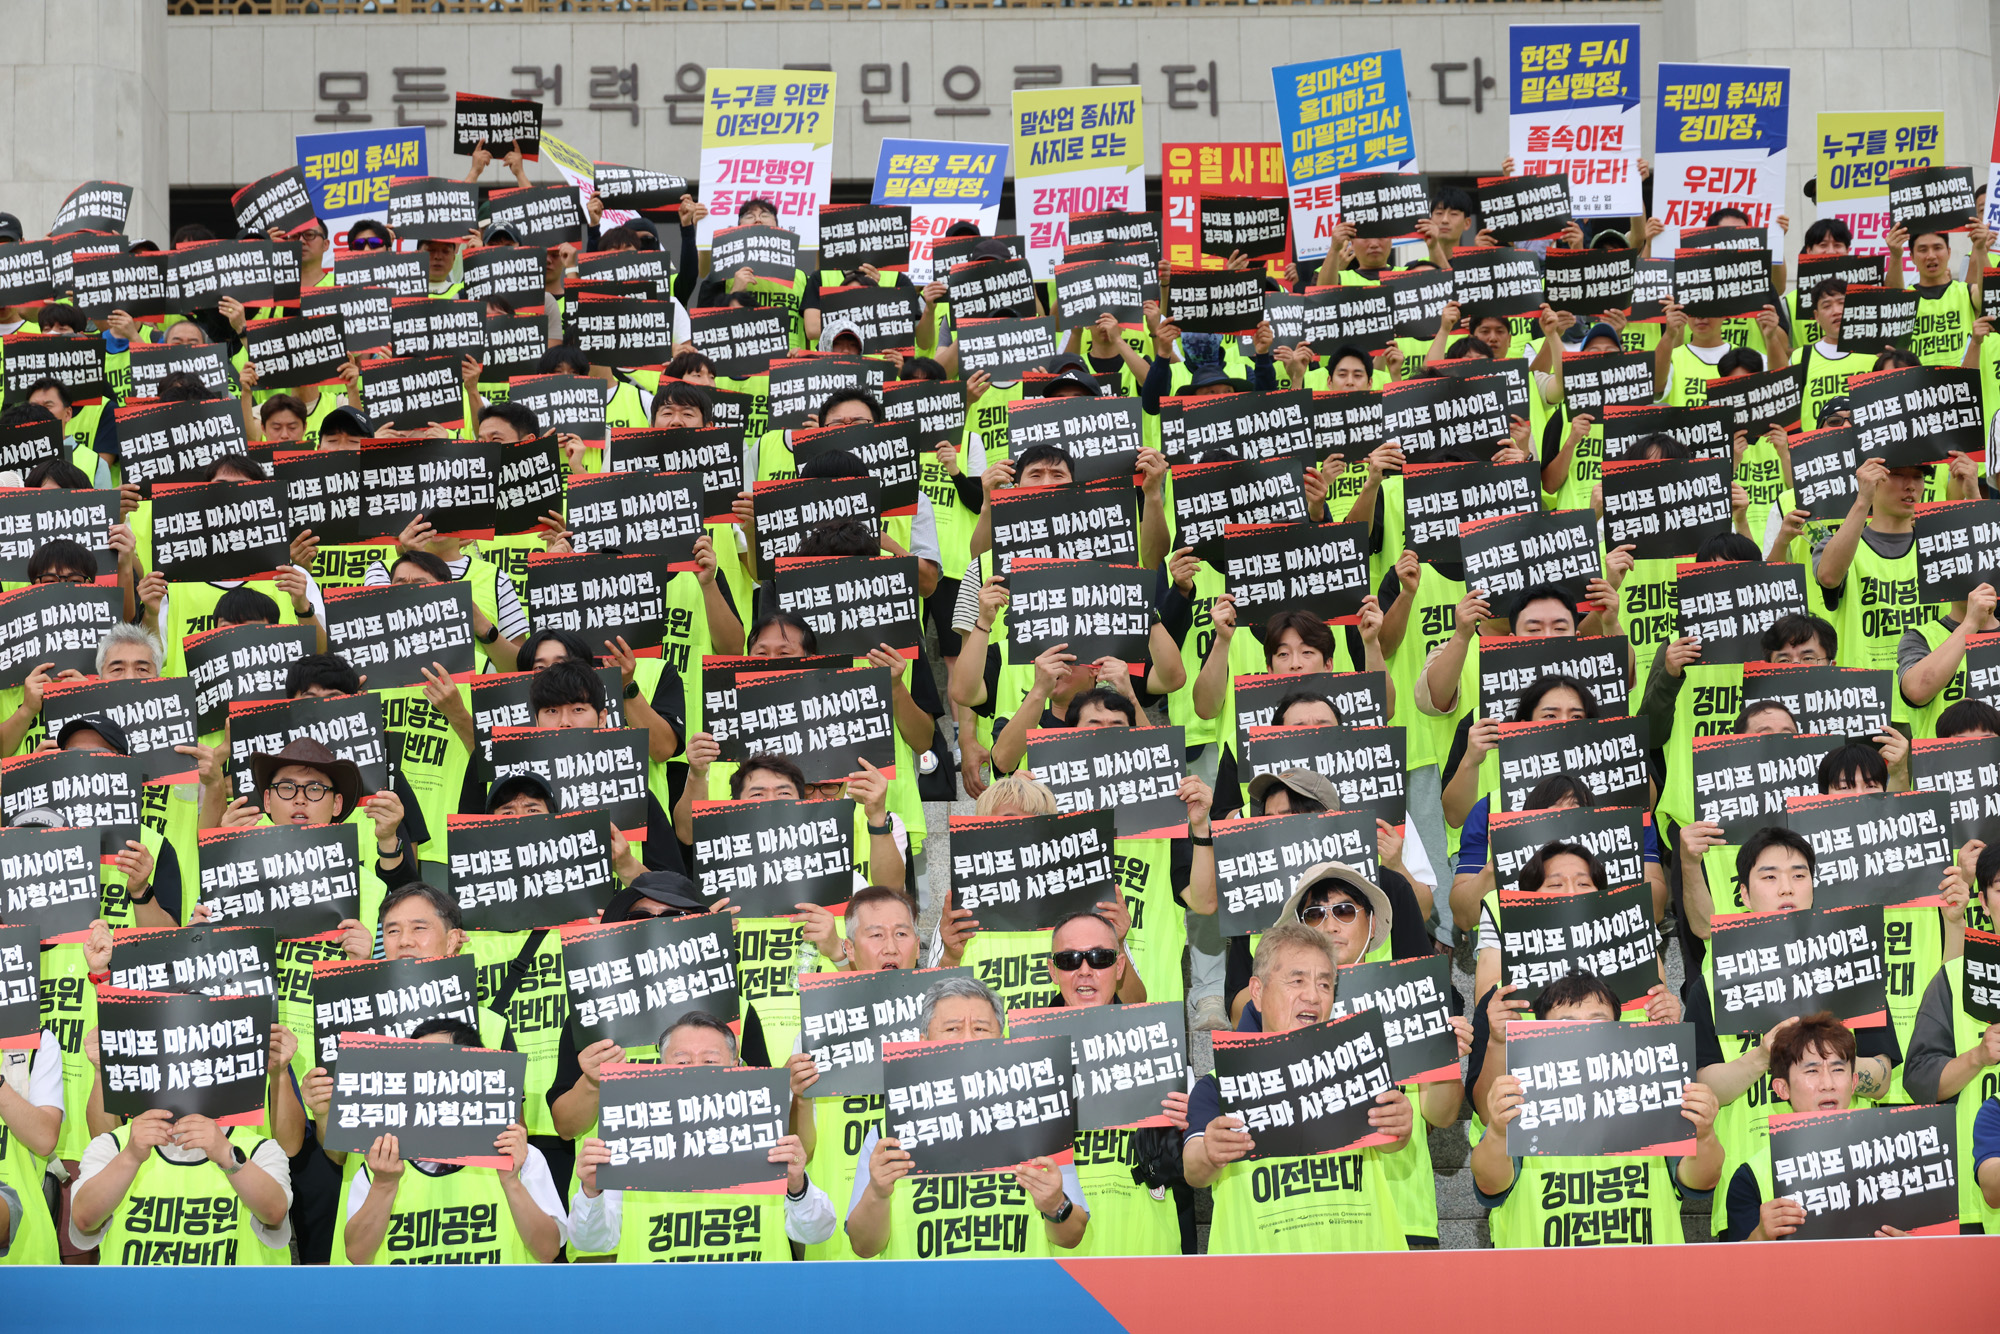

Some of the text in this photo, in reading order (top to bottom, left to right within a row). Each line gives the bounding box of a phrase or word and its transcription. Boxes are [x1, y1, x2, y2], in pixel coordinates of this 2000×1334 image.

[1520, 38, 1629, 73] 현장 무시
[315, 65, 450, 127] 모든
[711, 83, 829, 110] 누구를 위한
[1295, 56, 1382, 98] 경마산업
[1520, 70, 1628, 104] 밀실행정,
[1664, 81, 1782, 112] 국민의 휴식처
[1020, 100, 1136, 137] 말산업 종사자
[1299, 84, 1386, 124] 홀대하고
[716, 112, 819, 138] 이전인가?
[1292, 106, 1401, 154] 마필관리사
[1527, 124, 1624, 152] 졸속이전
[1680, 114, 1763, 142] 경마장,
[1823, 125, 1938, 159] 누구를 위한
[305, 140, 419, 181] 국민의 휴식처
[889, 154, 996, 175] 현장 무시
[1030, 132, 1127, 166] 사지로 모는
[1292, 134, 1408, 181] 생존권 뺏는
[716, 159, 814, 186] 기만행위
[884, 178, 989, 198] 밀실행정,
[1683, 165, 1757, 195] 우리가
[1891, 177, 1971, 205] 무대포 마사이전,
[1033, 185, 1129, 216] 강제이전
[1202, 212, 1231, 226] 무대포
[1234, 208, 1284, 226] 마사이전,
[1481, 184, 1570, 214] 무대포 마사이전,
[1484, 199, 1570, 231] 경주마 사형선고!
[1893, 194, 1975, 225] 경주마 사형선고!
[821, 216, 907, 240] 무대포 마사이전,
[823, 240, 857, 258] 경주마
[860, 233, 908, 251] 사형선고!
[1204, 223, 1285, 243] 경주마 사형선고!
[75, 265, 163, 289] 무대포 마사이전,
[77, 283, 164, 307] 경주마 사형선고!
[1170, 279, 1262, 302] 무대포 마사이전,
[578, 312, 669, 331] 무대포 마사이전,
[1171, 296, 1263, 320] 경주마 사형선고!
[579, 331, 671, 350] 경주마 사형선고!
[365, 368, 458, 399] 무대포 마사이전,
[367, 386, 461, 418] 경주마 사형선고!
[1853, 382, 1977, 426] 무대포 마사이전,
[1857, 407, 1981, 451] 경주마 사형선고!
[1605, 473, 1730, 515] 무대포 마사이전,
[154, 497, 282, 538] 무대포 마사이전,
[1609, 498, 1731, 541] 경주마 사형선고!
[156, 522, 287, 564] 경주마 사형선고!
[1228, 538, 1363, 580] 무대포 마사이전,
[1012, 584, 1148, 615] 무대포 마사이전,
[1230, 564, 1367, 607] 경주마 사형선고!
[1861, 574, 1918, 606] 경마공
[1014, 613, 1149, 643] 경주마 사형선고!
[202, 842, 352, 892] 무대포 마사이전,
[954, 828, 1110, 879] 무대포 마사이전,
[206, 872, 357, 923] 경주마 사형선고!
[958, 856, 1112, 910] 경주마 사형선고!
[568, 933, 733, 994] 무대포 마사이전,
[1716, 925, 1880, 980] 무대포 마사이전,
[979, 953, 1052, 992] 경마공
[1721, 955, 1882, 1011] 경주마 사형선고!
[575, 963, 735, 1027] 경주마 사형선고!
[337, 1069, 514, 1096] 무대포 마사이전,
[888, 1057, 1064, 1115] 무대포 마사이전,
[1511, 1043, 1688, 1094] 무대포 마사이전,
[338, 1100, 517, 1128] 경주마 사형선고!
[603, 1087, 780, 1131] 무대포 마사이전,
[893, 1090, 1070, 1151] 경주마 사형선고!
[1515, 1077, 1691, 1130] 경주마 사형선고!
[605, 1120, 783, 1166] 경주마 사형선고!
[912, 1173, 1026, 1215] 경마공원
[1252, 1154, 1363, 1203] 이전반대
[1541, 1162, 1649, 1210] 경마공원
[125, 1196, 238, 1236] 경마공원
[387, 1203, 498, 1252] 경마공원
[649, 1204, 761, 1253] 경마공원
[1544, 1206, 1652, 1247] 이전반대
[917, 1213, 1029, 1260] 이전반대
